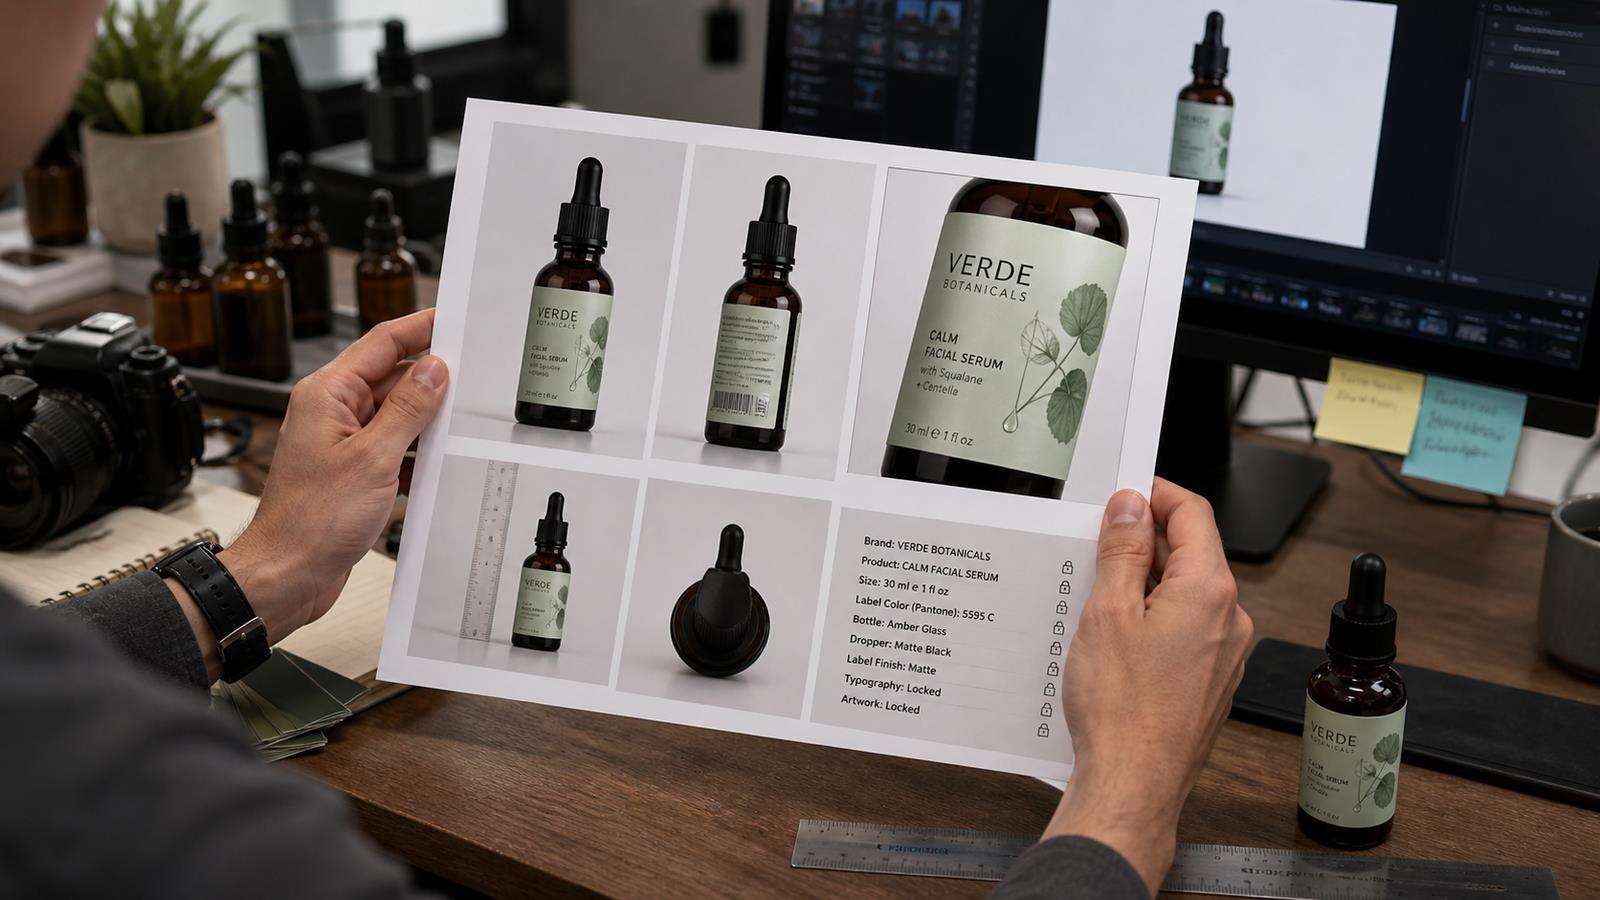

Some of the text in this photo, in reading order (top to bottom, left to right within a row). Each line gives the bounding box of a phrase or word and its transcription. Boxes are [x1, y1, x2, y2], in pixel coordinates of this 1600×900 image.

[949, 252, 1034, 286] VERDE
[943, 279, 1027, 302] BOTANICALS
[538, 306, 578, 322] VERDE
[929, 329, 959, 344] CALM
[924, 346, 1004, 371] FACIAL SERUM
[920, 365, 983, 385] with Squalane
[905, 423, 916, 434] 30
[917, 426, 930, 437] ml
[943, 430, 949, 441] 1
[950, 431, 959, 443] fl
[960, 436, 974, 446] oz
[864, 536, 992, 562] Brand: VERDE BOTANICALS
[861, 556, 999, 583] Product: CALM FACIAL SERUM
[859, 575, 949, 597] Size: 30 ml e 1 fl oz
[855, 595, 995, 622] Label Color (Pantone): 5595 C
[853, 614, 947, 636] Bottle: Amber Glass
[850, 634, 952, 657] Dropper: Matte Black
[847, 654, 937, 675] Label Finish: Matte
[844, 674, 942, 697] Typography: Locked
[841, 694, 920, 715] Artwork: Locked
[1310, 720, 1357, 747] VERDE
